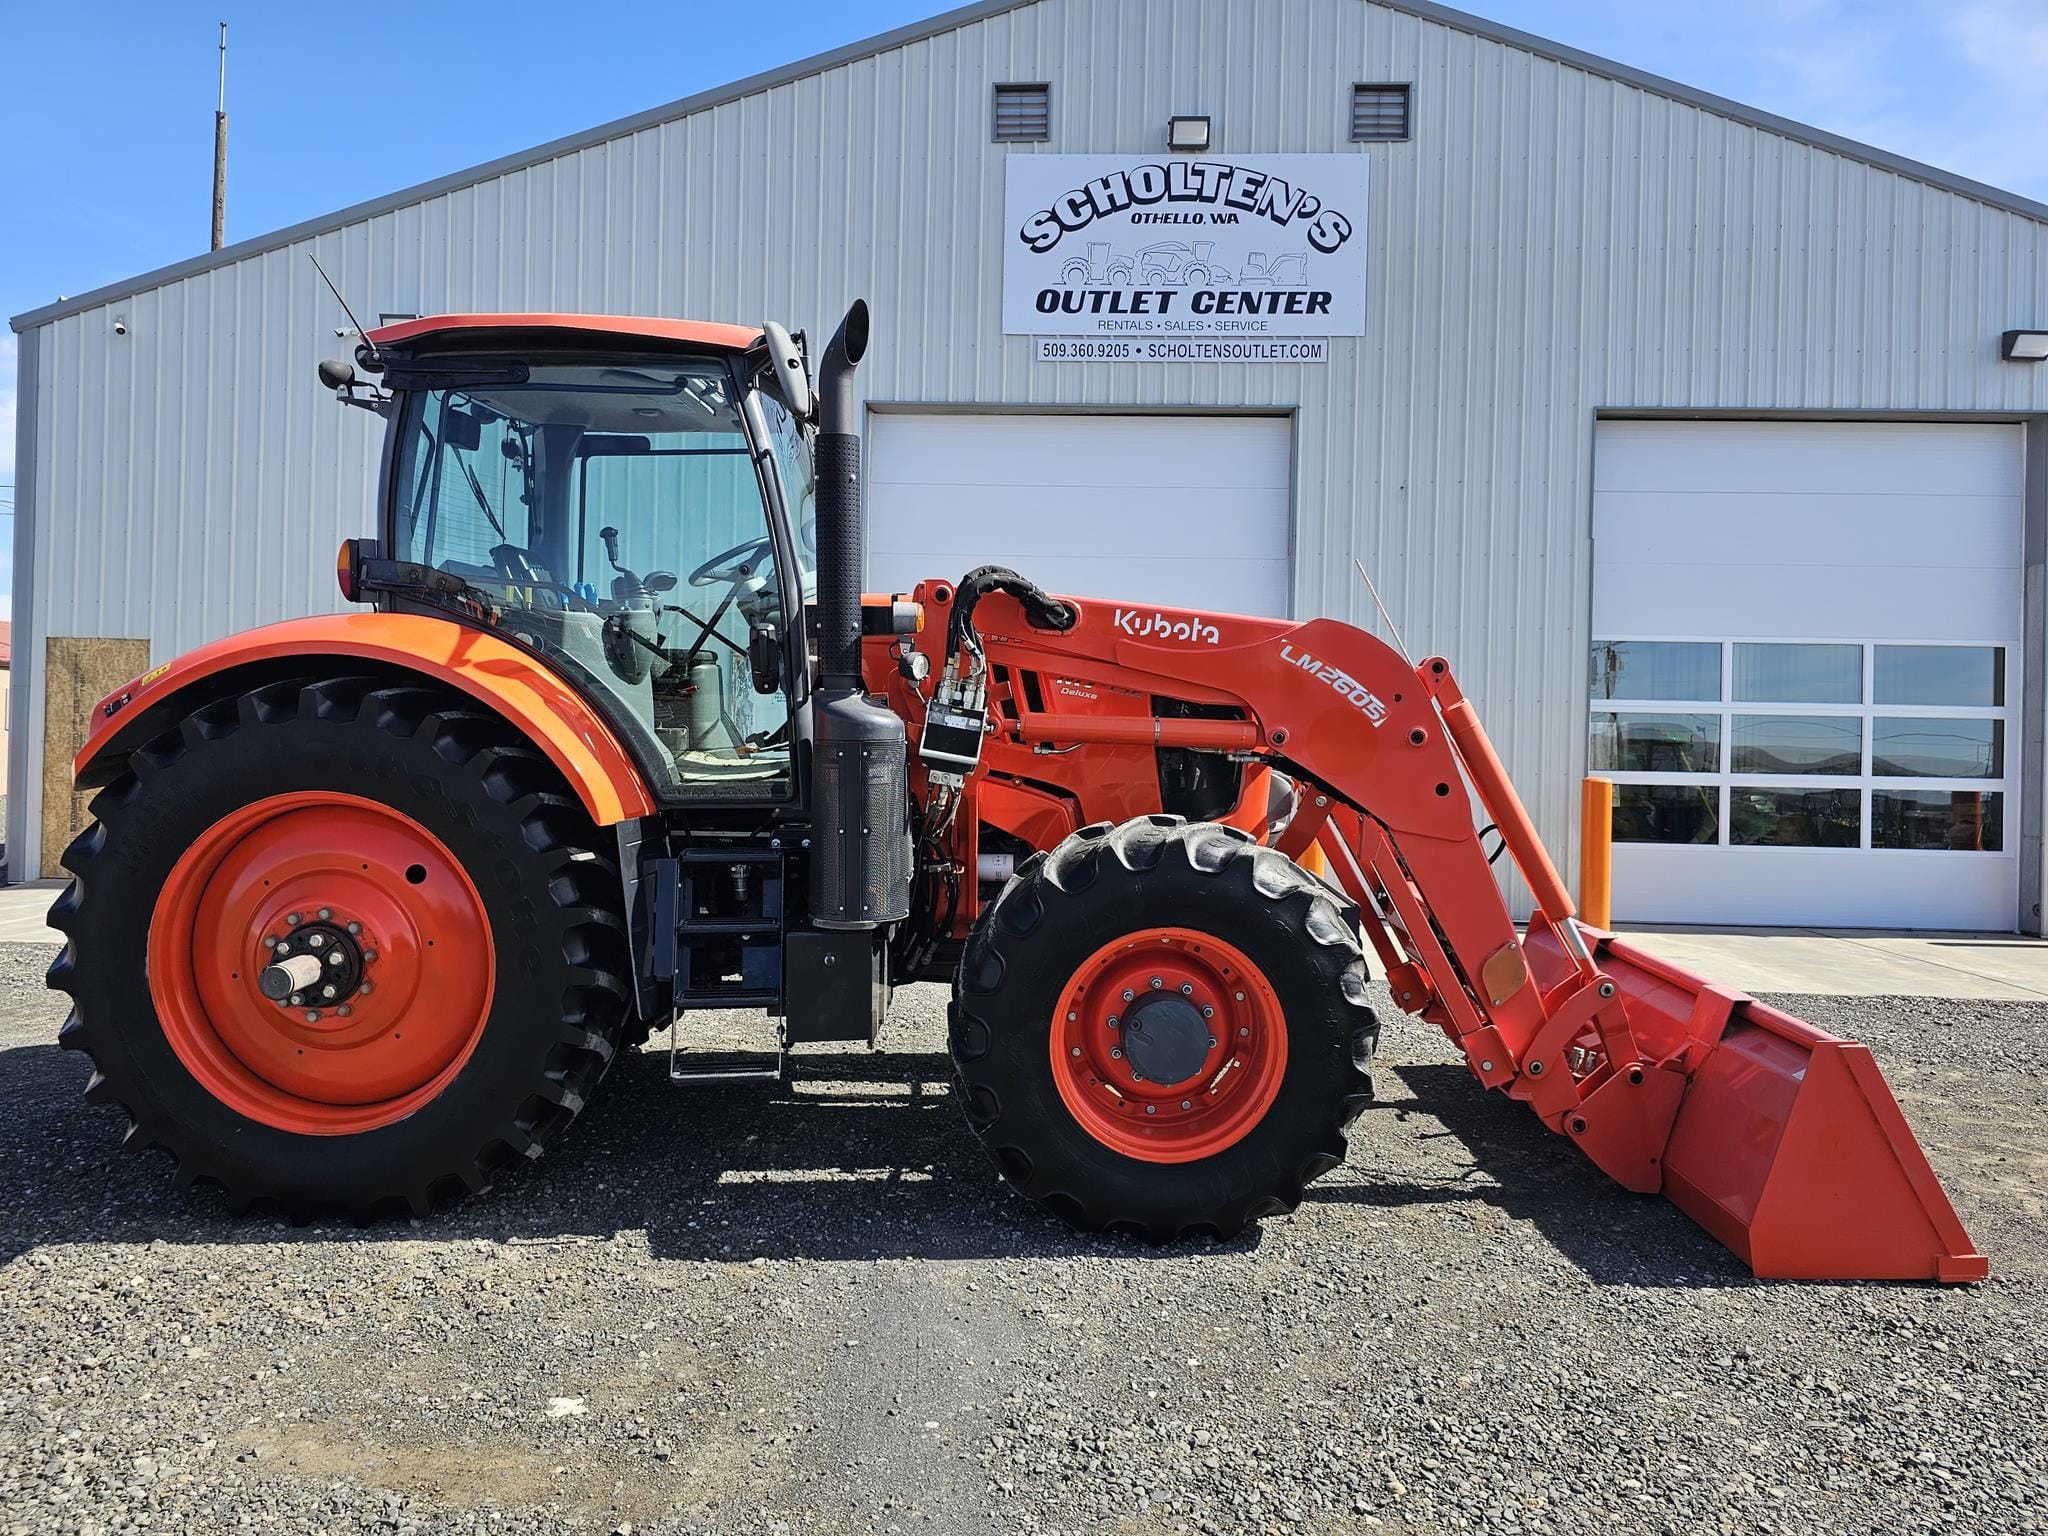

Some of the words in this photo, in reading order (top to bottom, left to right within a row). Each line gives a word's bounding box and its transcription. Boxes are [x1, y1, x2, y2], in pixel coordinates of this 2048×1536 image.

[1210, 213, 1239, 224] WA
[1035, 289, 1178, 314] OUTLET
[1190, 290, 1333, 315] CENTER
[1098, 320, 1153, 331] RENTALS
[1164, 320, 1204, 331] SALES
[1214, 320, 1268, 331] SERVICE
[1043, 343, 1130, 358] 509.360.9205
[1148, 343, 1322, 359] SCHOLTENSOUTLET.COM
[1113, 608, 1220, 644] Kubota
[1280, 644, 1387, 721] LM2605
[1060, 687, 1098, 700] Deluxe
